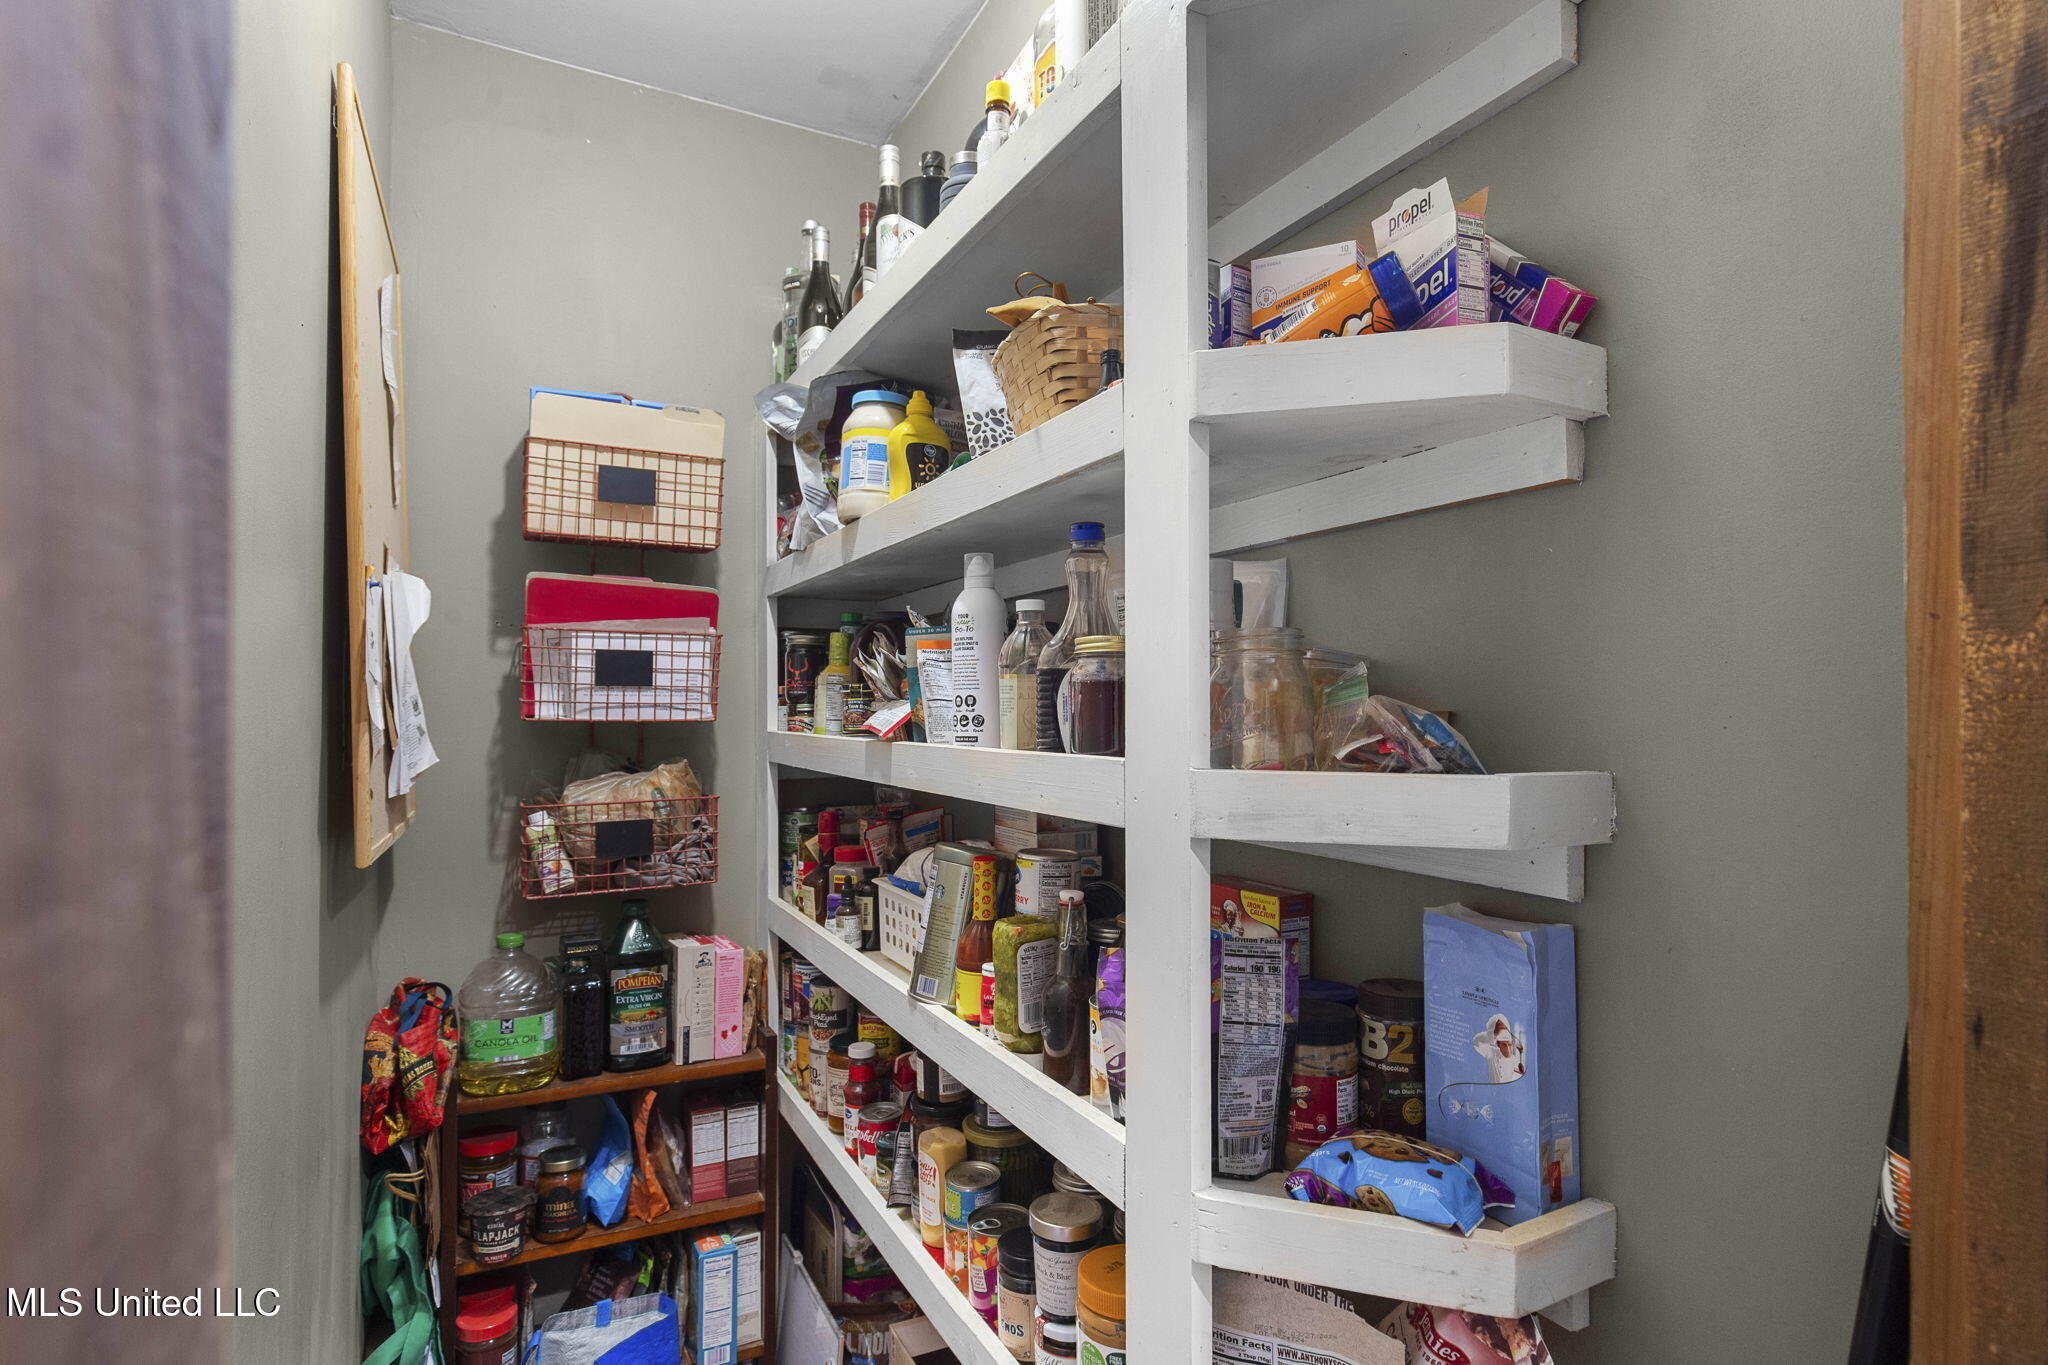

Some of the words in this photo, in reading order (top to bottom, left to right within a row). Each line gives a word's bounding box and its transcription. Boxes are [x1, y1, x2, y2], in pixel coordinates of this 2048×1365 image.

[1389, 191, 1434, 237] propel
[1275, 295, 1301, 311] IMMUNE
[1302, 279, 1331, 297] SUPPORT
[1247, 901, 1260, 910] IRON
[1249, 908, 1276, 920] CALCIUM
[1224, 963, 1245, 972] Calories
[617, 975, 663, 991] POMPEIAN
[616, 994, 639, 1005] EXTRA
[640, 991, 663, 1002] VIRGIN
[624, 1024, 654, 1033] SMOOTH
[474, 1037, 519, 1050] CANOLA
[522, 1034, 539, 1044] OIL
[1360, 1019, 1415, 1065] B2
[1377, 1063, 1409, 1074] chocolate
[1389, 1088, 1401, 1096] High
[545, 1201, 575, 1211] mina
[473, 1224, 520, 1242] FLAPJACK
[1056, 1272, 1072, 1281] Blue
[1293, 1281, 1329, 1303] UNDER
[1331, 1294, 1354, 1312] THE
[1212, 1329, 1239, 1344] rition
[1241, 1337, 1272, 1353] Facts
[1243, 1353, 1257, 1361] Tbsp
